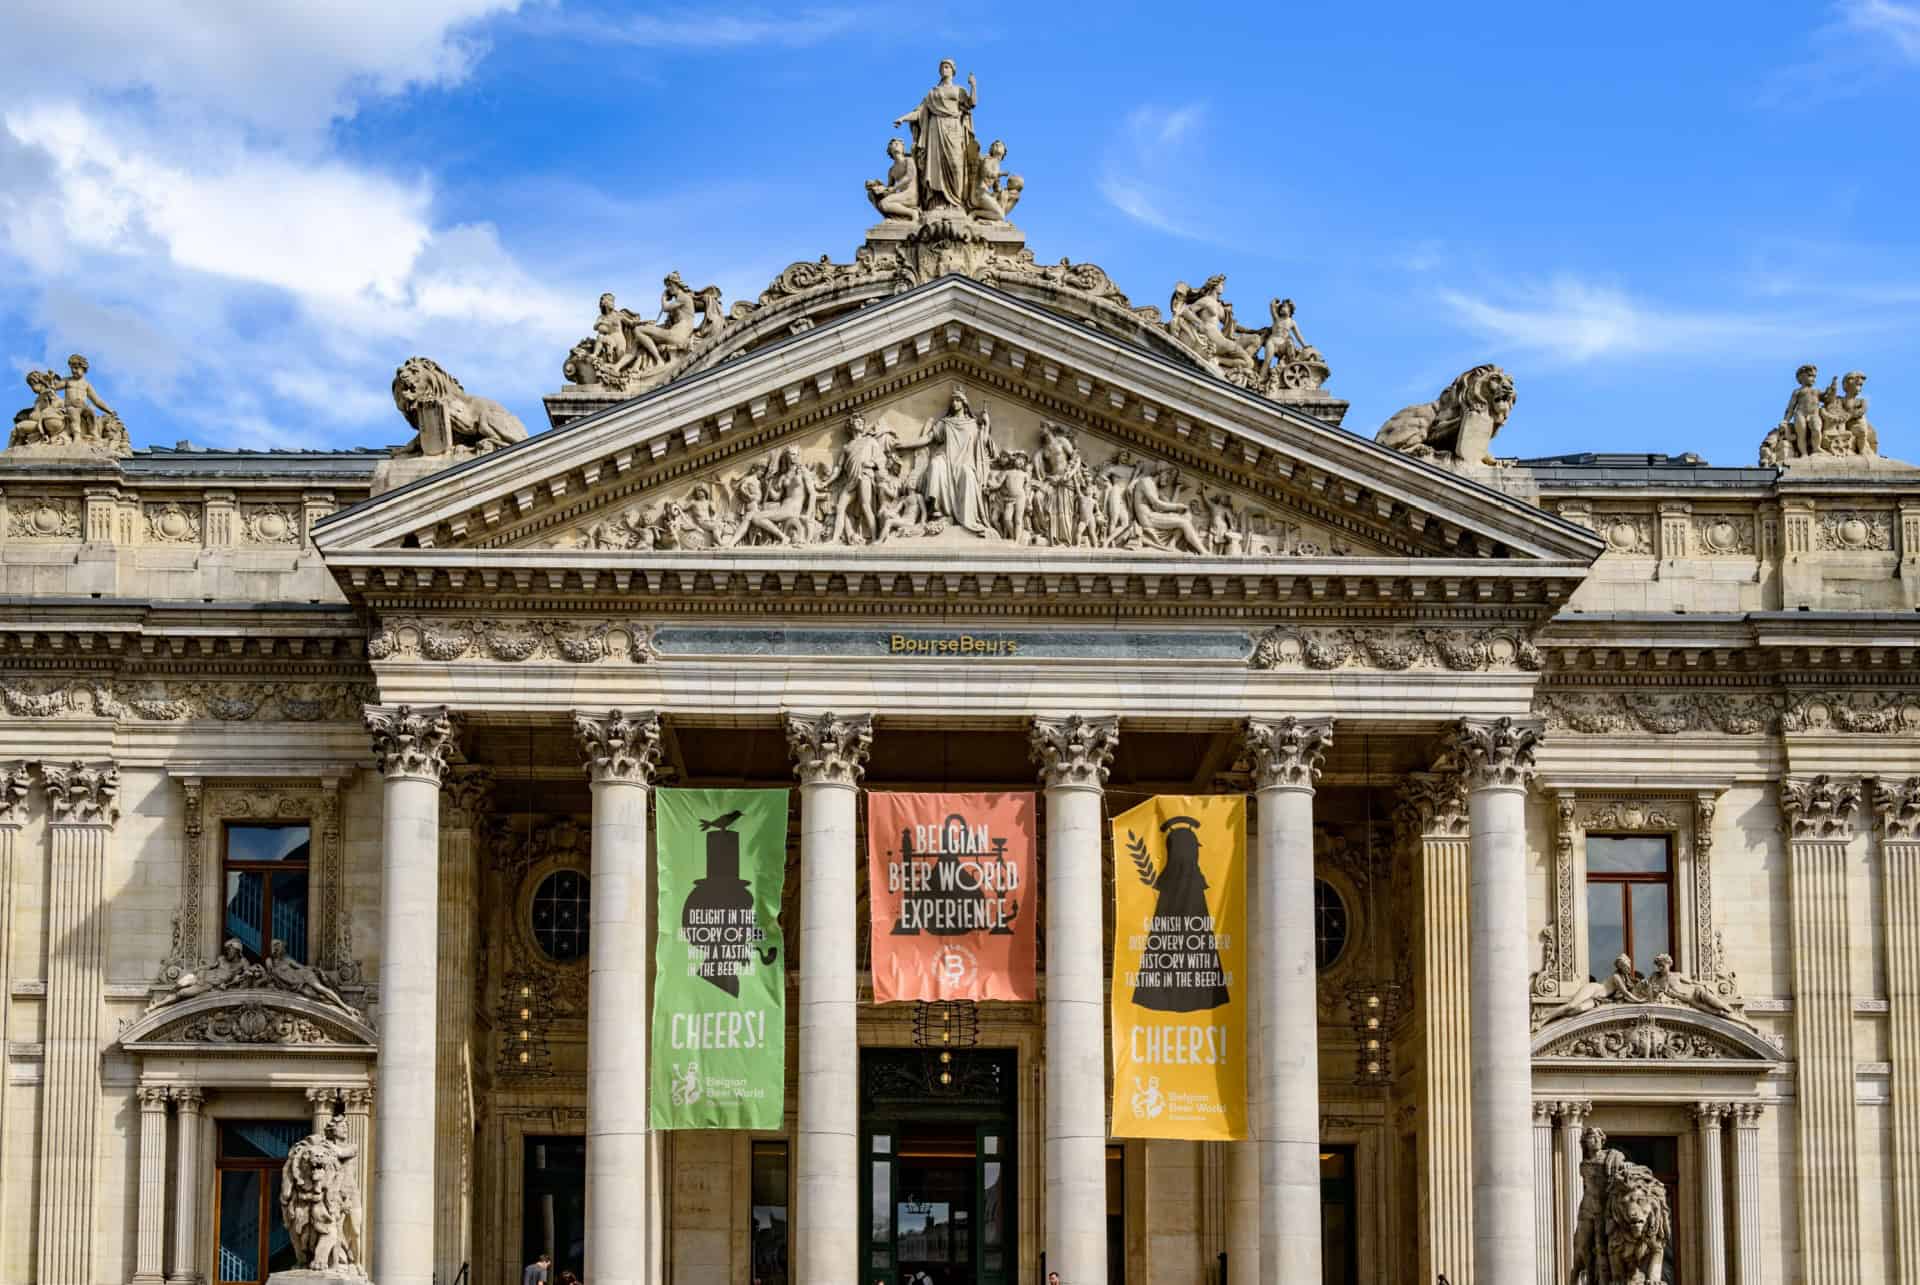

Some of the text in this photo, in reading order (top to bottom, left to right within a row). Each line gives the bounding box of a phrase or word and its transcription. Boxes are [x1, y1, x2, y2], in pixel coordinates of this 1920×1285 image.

[891, 635, 1017, 651] BourseBeurs
[889, 861, 1019, 891] BEER WORLD
[740, 909, 757, 925] THE
[1184, 916, 1216, 931] YOUR
[724, 927, 744, 943] OF
[1186, 935, 1206, 950] OF
[712, 945, 719, 960] A
[1213, 953, 1220, 969] A
[700, 962, 715, 977] THE
[1175, 971, 1193, 987] THE
[671, 1010, 766, 1049] CHEERS!
[1131, 1025, 1227, 1064] CHEERS!
